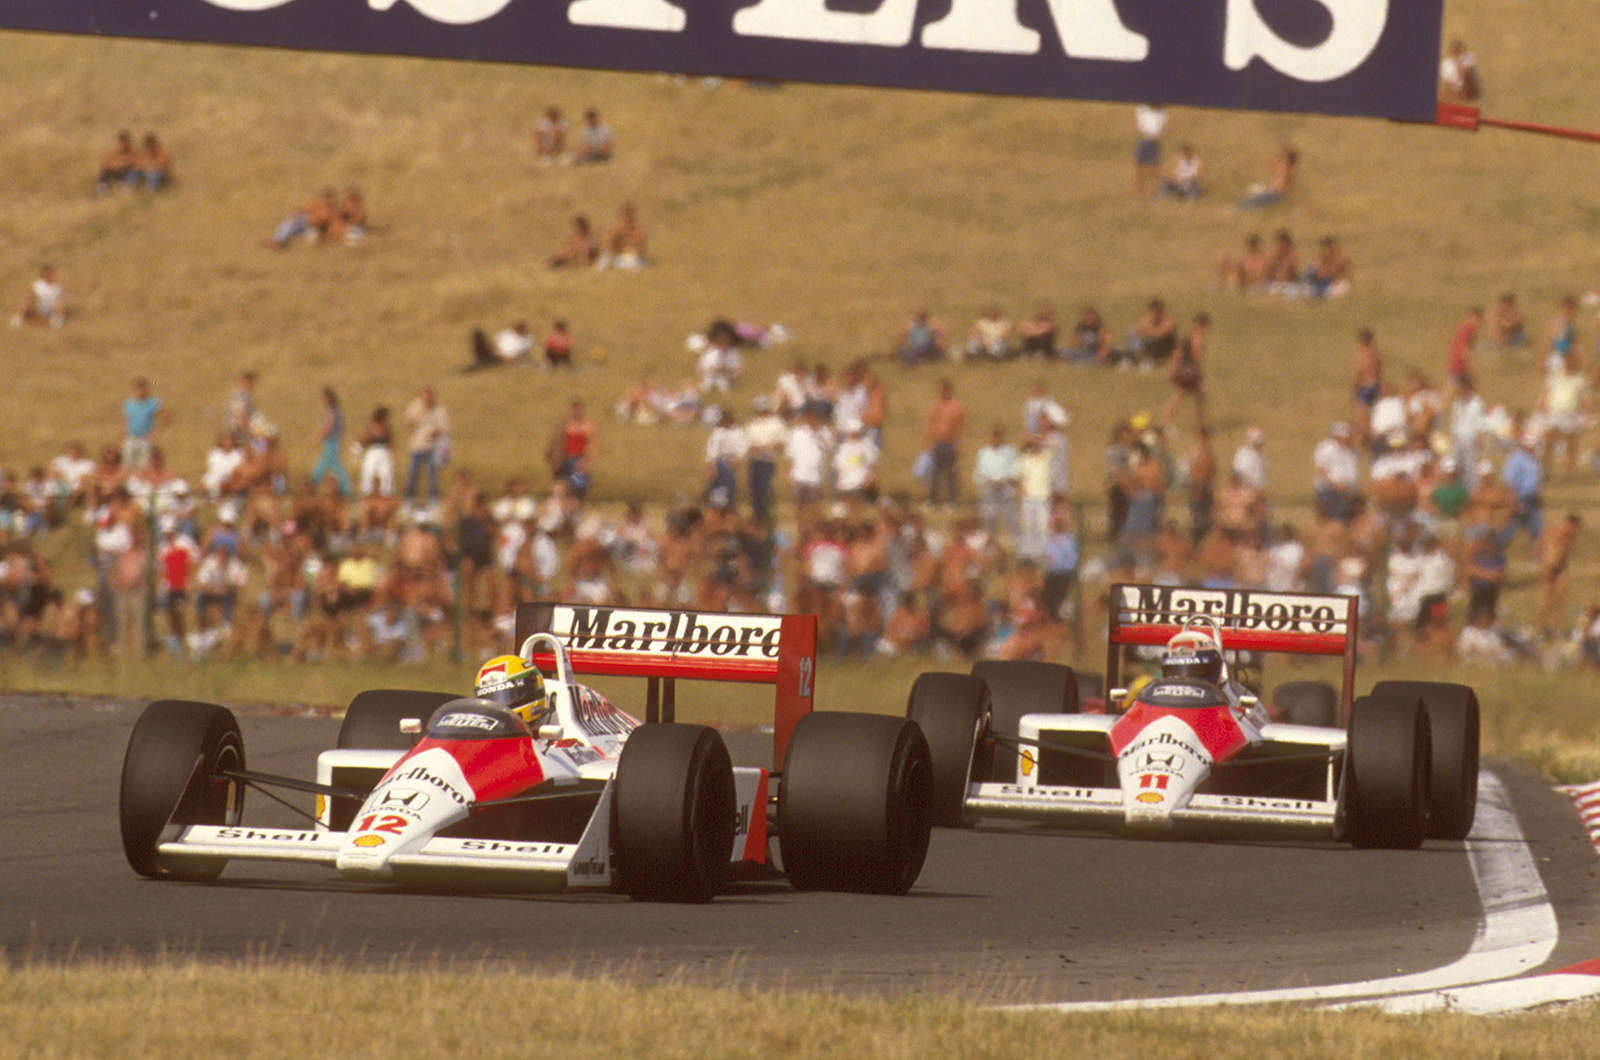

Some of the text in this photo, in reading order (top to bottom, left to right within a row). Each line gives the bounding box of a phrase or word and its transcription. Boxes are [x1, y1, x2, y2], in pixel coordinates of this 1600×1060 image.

[1132, 588, 1335, 632] Marlboro
[566, 607, 781, 657] Marlboro
[1163, 656, 1201, 665] HONDA
[799, 656, 812, 698] 12
[477, 680, 515, 696] HONDA
[1139, 773, 1170, 790] 11
[1001, 785, 1092, 798] Shell
[1221, 797, 1312, 809] Shell
[356, 814, 408, 835] 12
[216, 829, 319, 842] Shell
[461, 841, 565, 854] Shell
